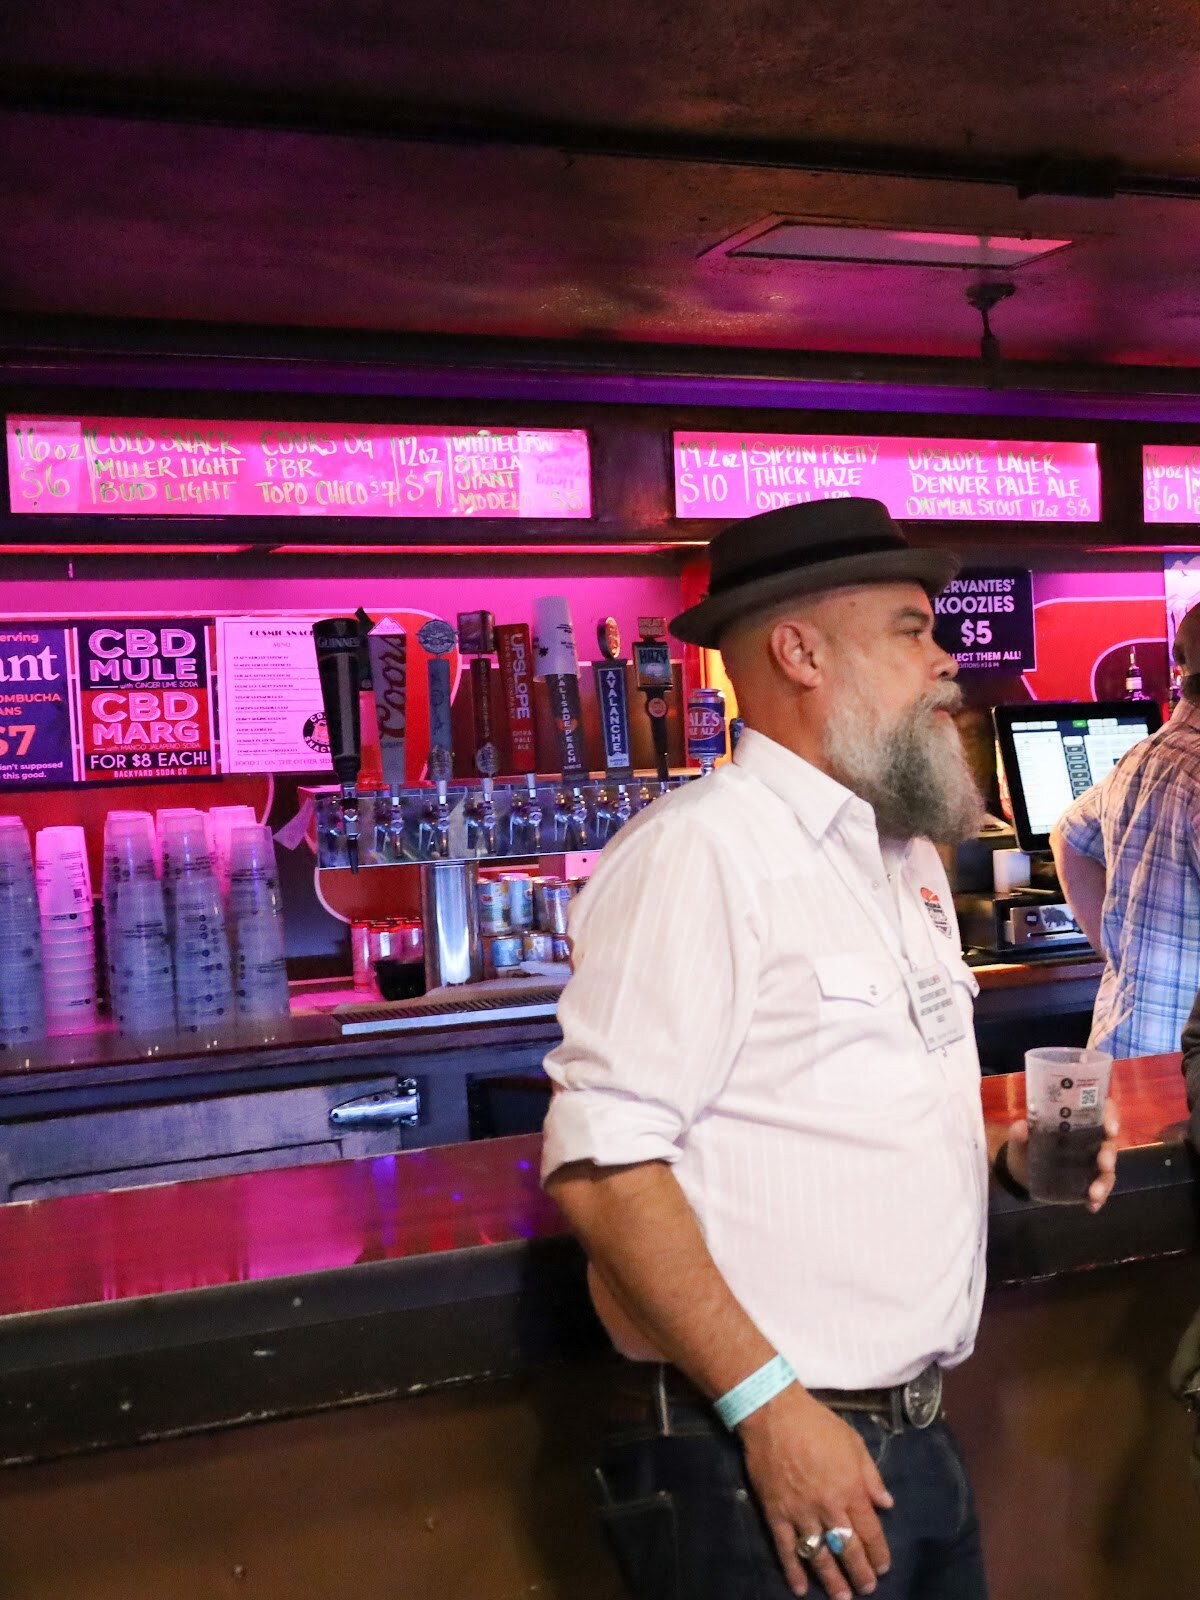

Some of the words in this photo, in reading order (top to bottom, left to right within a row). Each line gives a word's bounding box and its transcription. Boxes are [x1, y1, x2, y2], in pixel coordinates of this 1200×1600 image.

[91, 429, 155, 455] COLD
[161, 430, 241, 456] SNACK
[750, 441, 816, 466] SIPPIN
[822, 443, 880, 465] PRETTY
[94, 457, 178, 479] MILLER
[181, 457, 246, 476] LIGHT
[265, 458, 323, 478] PBR
[453, 455, 525, 474] STELLA
[908, 448, 988, 473] UPSLOPE
[997, 450, 1060, 476] LAGER
[405, 469, 444, 508] $7
[457, 471, 518, 490] JIANT
[680, 468, 728, 510] $10
[751, 466, 808, 487] THICK
[814, 466, 863, 489] HAZE
[909, 470, 990, 495] DENVER
[996, 475, 1040, 497] PALE
[1047, 477, 1080, 498] ALE
[101, 481, 157, 502] BUD
[165, 480, 237, 501] LIGHT
[255, 481, 308, 505] TOPO
[906, 496, 976, 517] OATMEAL
[978, 498, 1024, 516] STOUT
[1066, 497, 1091, 516] $8
[943, 579, 1015, 593] ERVANTES'
[934, 595, 1015, 614] KOOZIES
[0, 632, 39, 644] erving
[88, 629, 196, 658] CBD
[961, 619, 993, 646] $5
[951, 652, 973, 662] LECT
[975, 651, 1001, 661] THEM
[1003, 650, 1021, 660] ALL!
[89, 658, 198, 681] MULE
[510, 633, 531, 720] UPSLOPE
[135, 681, 160, 689] GINGER
[92, 692, 199, 722] CBD
[606, 670, 622, 752] AVALANCHE
[92, 721, 200, 746] MARG
[565, 729, 577, 763] PEACH
[20, 762, 63, 771] supposed
[91, 754, 127, 769] FOR
[132, 753, 152, 767] $8
[158, 751, 208, 767] EACH!
[2, 772, 20, 780] this
[22, 771, 47, 781] good.
[114, 769, 153, 778] BACKYARD
[155, 768, 175, 776] SODA
